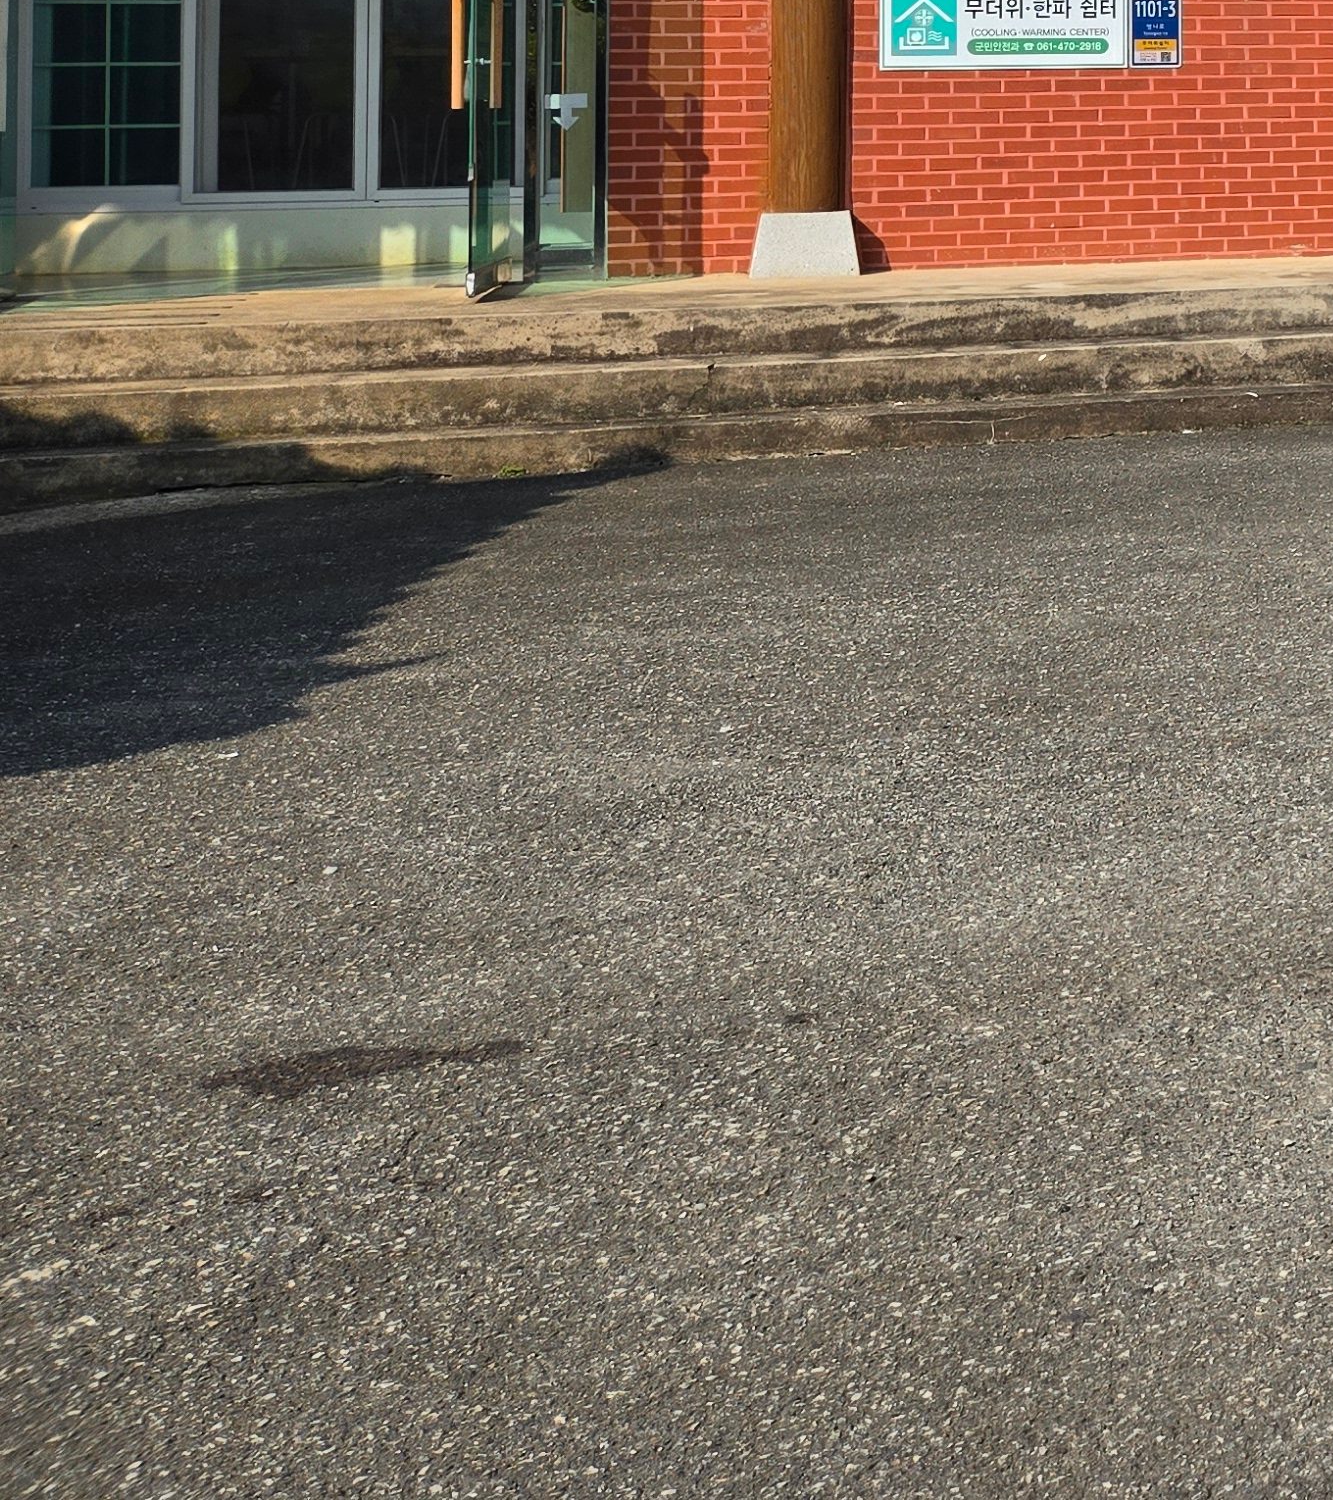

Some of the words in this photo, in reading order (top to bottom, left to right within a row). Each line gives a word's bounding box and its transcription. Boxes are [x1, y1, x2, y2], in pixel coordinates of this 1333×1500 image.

[1134, 0, 1176, 17] 1101-3
[1069, 27, 1110, 36] CENTER)
[974, 41, 1020, 52] 군민안전과
